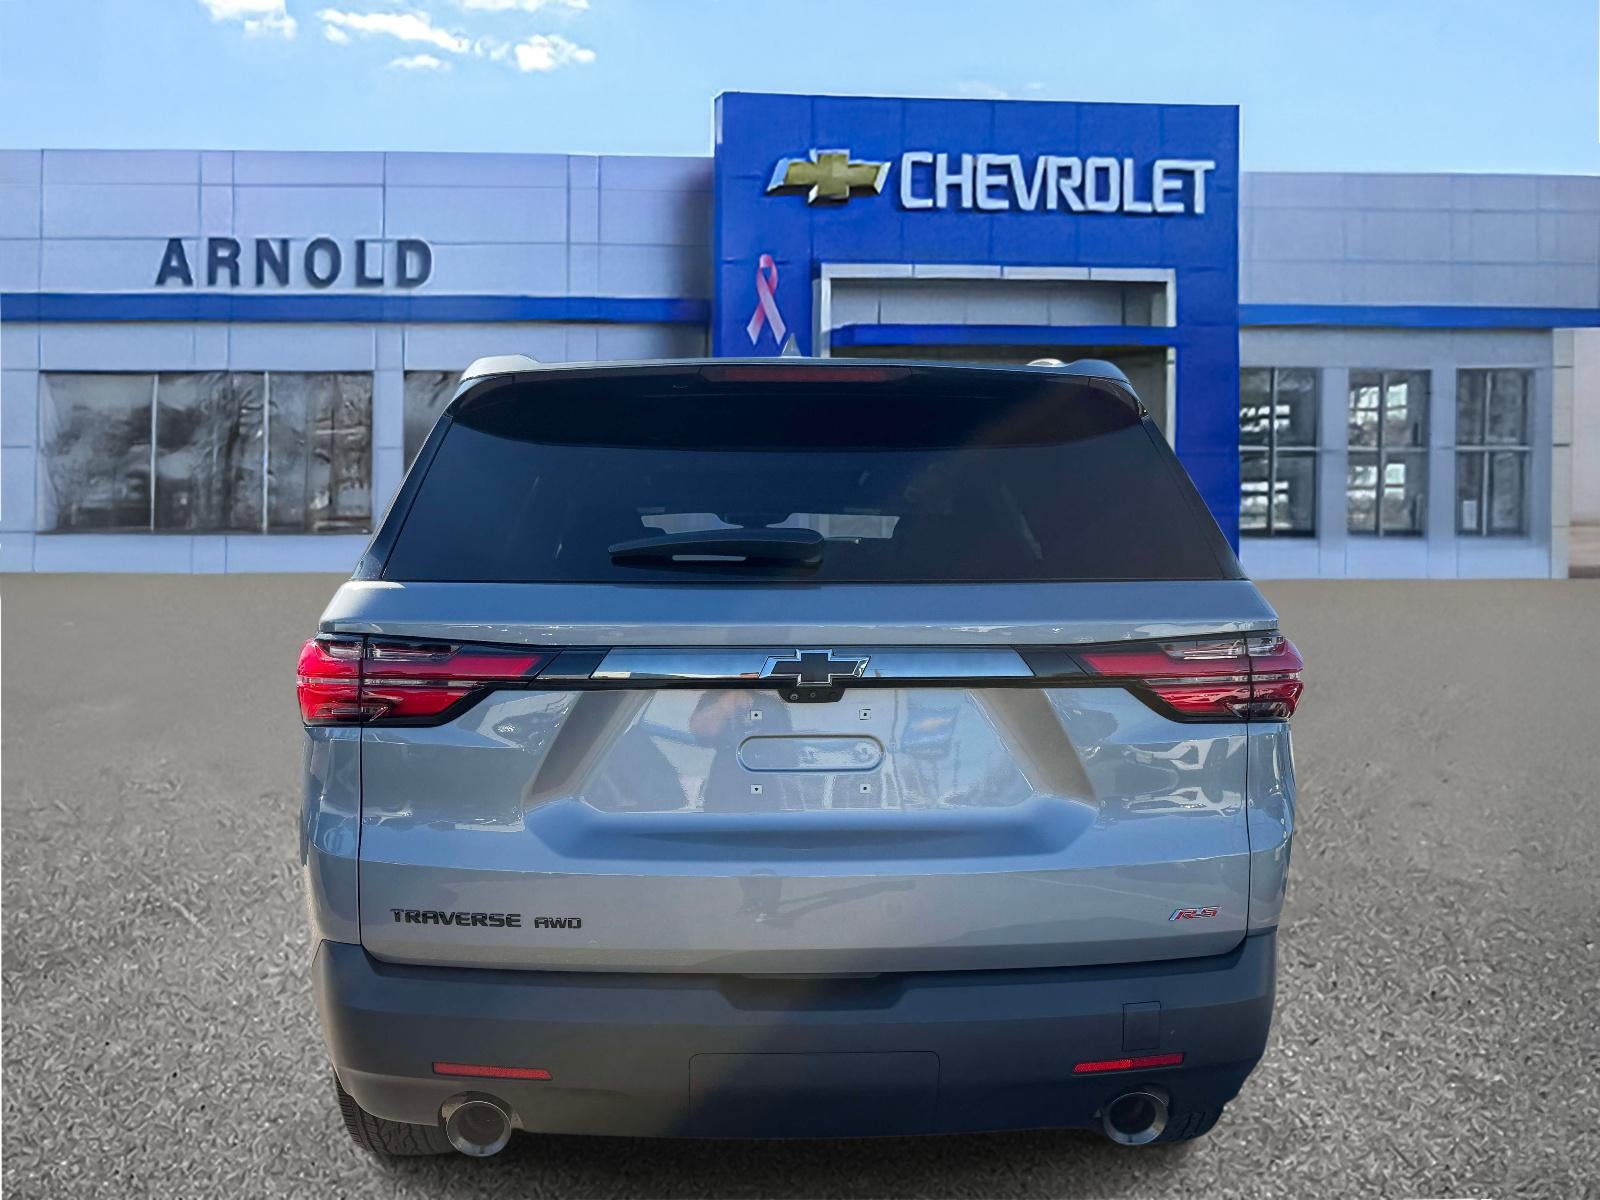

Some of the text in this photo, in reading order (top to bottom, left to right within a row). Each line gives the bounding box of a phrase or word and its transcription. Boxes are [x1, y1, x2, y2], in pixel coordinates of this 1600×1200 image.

[900, 151, 1216, 215] CHEVROLET
[156, 236, 434, 289] ARNOLD
[390, 908, 582, 929] TRAVERSE AWD
[1168, 906, 1222, 921] RS
